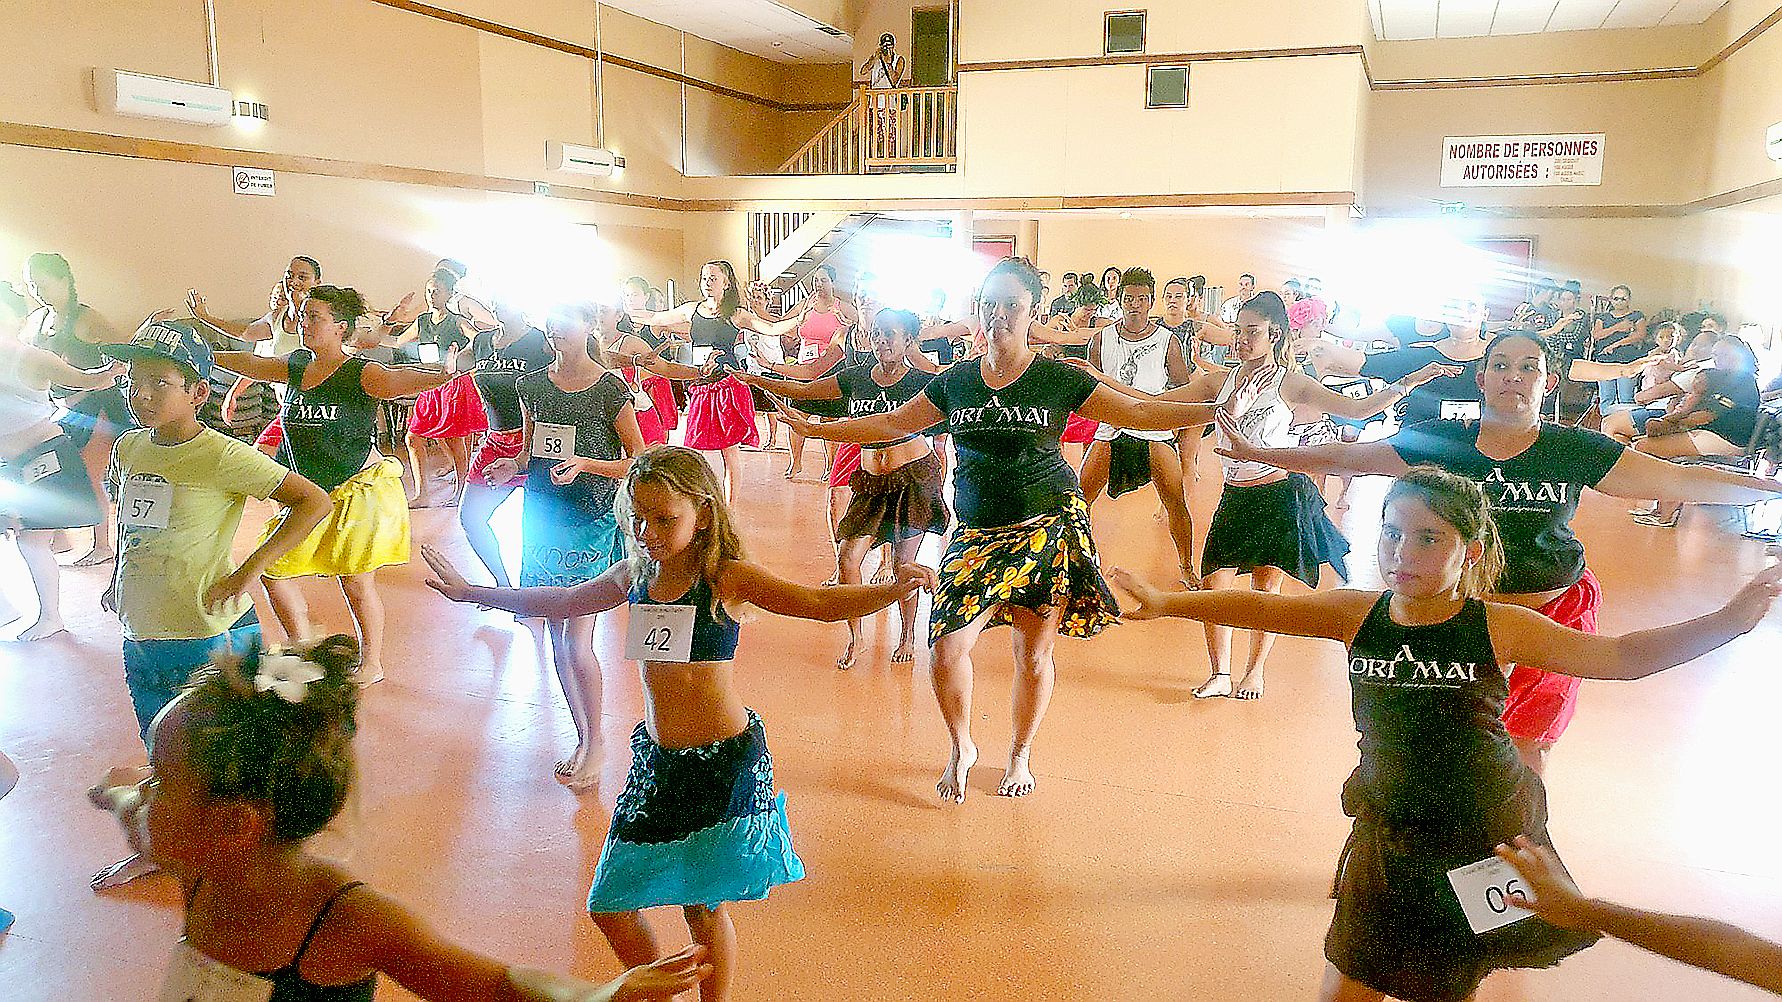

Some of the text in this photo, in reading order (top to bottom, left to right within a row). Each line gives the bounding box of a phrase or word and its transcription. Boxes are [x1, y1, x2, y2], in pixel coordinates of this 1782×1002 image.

[1449, 140, 1598, 160] NOMBRE DE PERSONNES
[1462, 160, 1539, 180] AUTORISÉES
[294, 404, 339, 420] MAI
[949, 405, 1049, 427] ORI MAI
[543, 437, 562, 454] 58
[1498, 481, 1569, 504] MAI
[131, 498, 155, 519] 57
[644, 627, 671, 652] 42
[1349, 657, 1477, 682] ORI MAI
